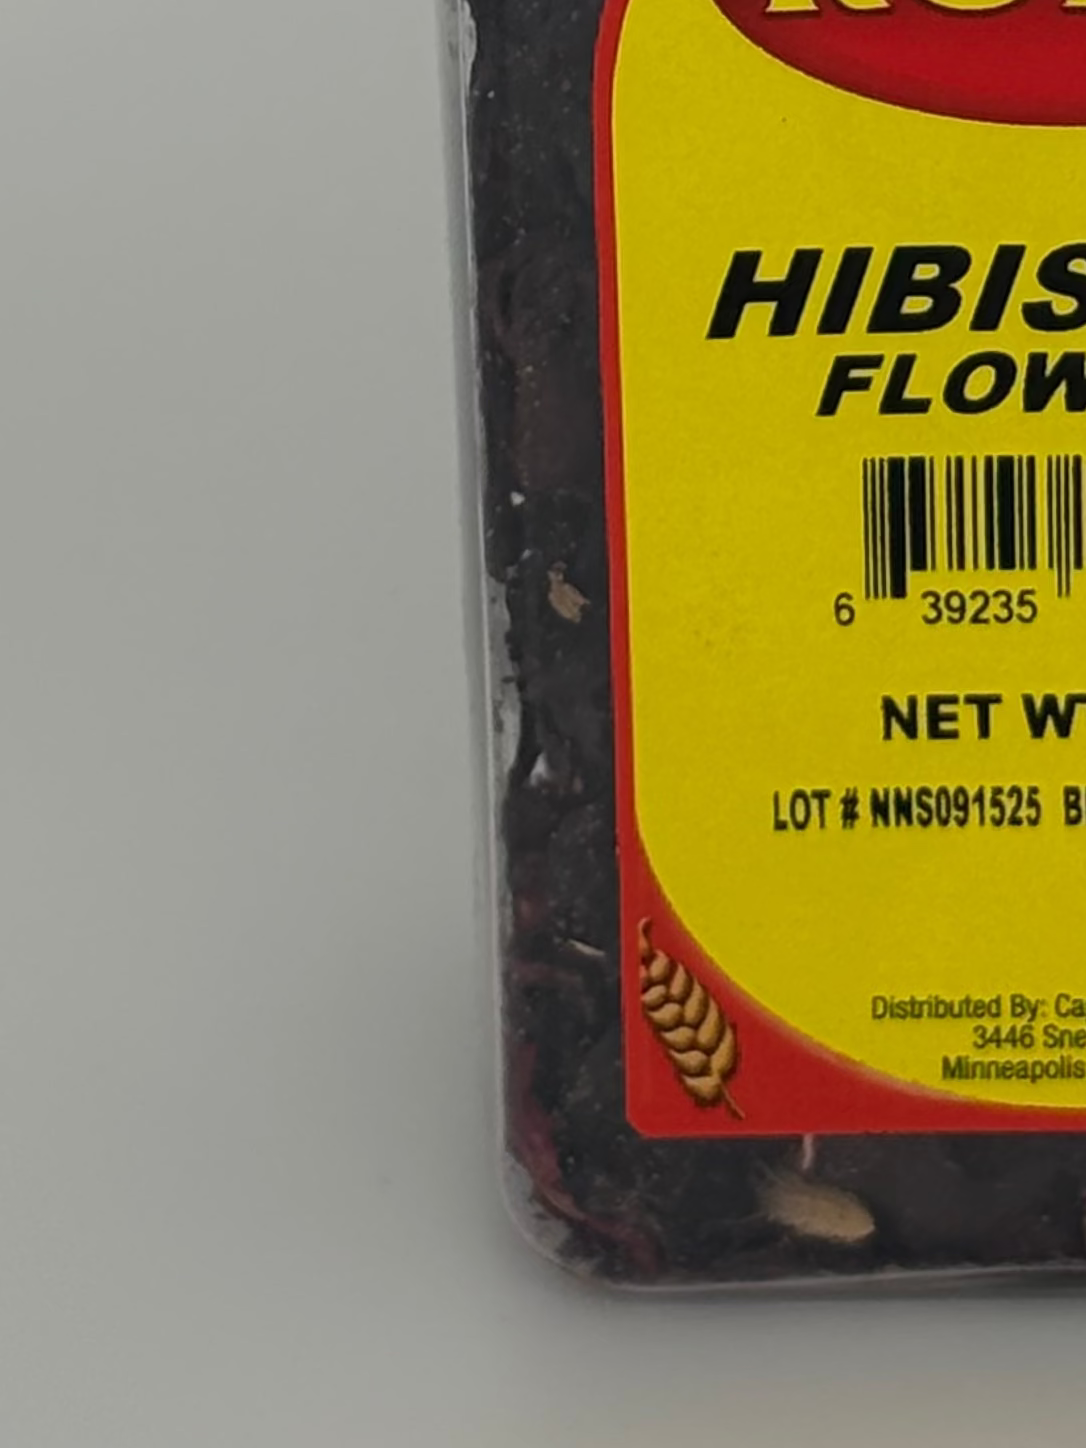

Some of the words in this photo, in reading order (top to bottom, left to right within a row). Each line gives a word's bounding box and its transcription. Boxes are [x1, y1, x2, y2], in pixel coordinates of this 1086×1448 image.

[833, 592, 856, 627] 6
[921, 588, 1039, 625] 39235
[881, 693, 1003, 741] NET
[772, 789, 832, 832] LOT
[840, 788, 860, 831] #
[870, 994, 1001, 1021] Distributed
[1009, 993, 1048, 1023] By:
[972, 1024, 1035, 1049] 3446
